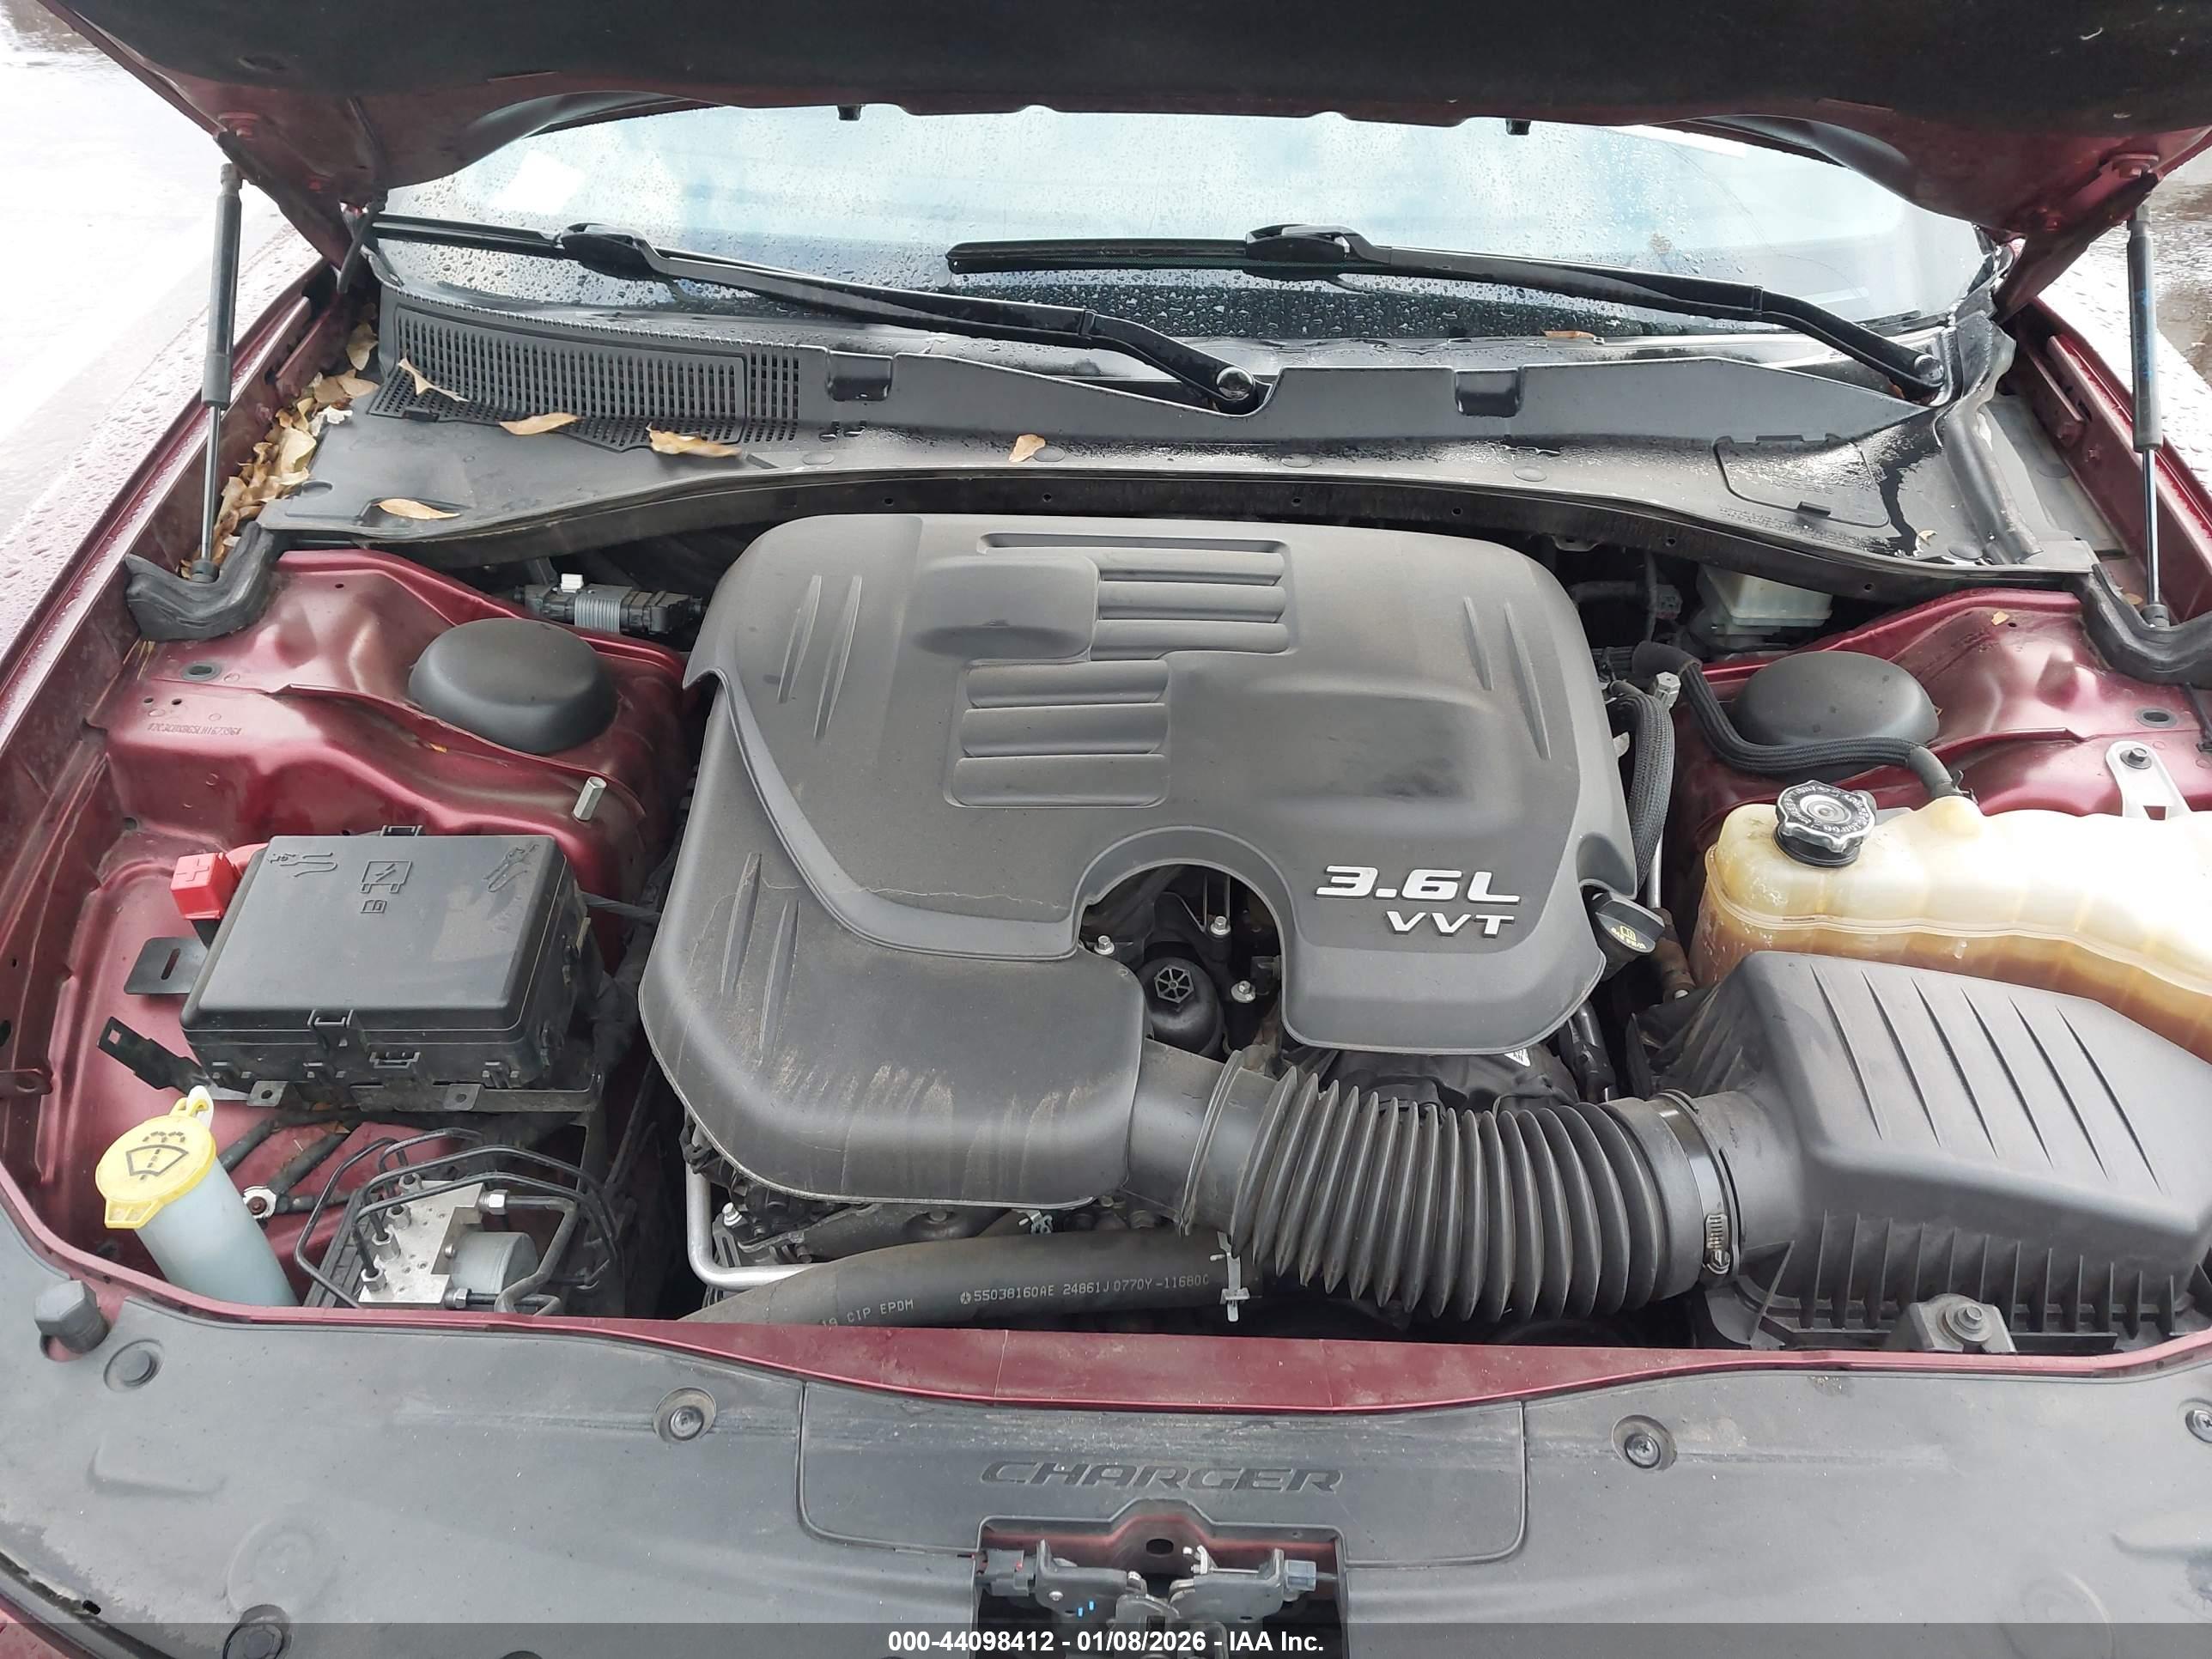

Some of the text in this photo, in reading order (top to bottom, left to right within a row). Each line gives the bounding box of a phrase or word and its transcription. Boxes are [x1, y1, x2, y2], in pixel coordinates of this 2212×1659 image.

[1315, 865, 1521, 905] 3.6L
[1385, 910, 1516, 939] VVT
[847, 1307, 872, 1323] CIP
[879, 1298, 914, 1315] EPDM
[974, 1285, 1054, 1302] 55038160AE
[981, 1462, 1343, 1493] CHARGER
